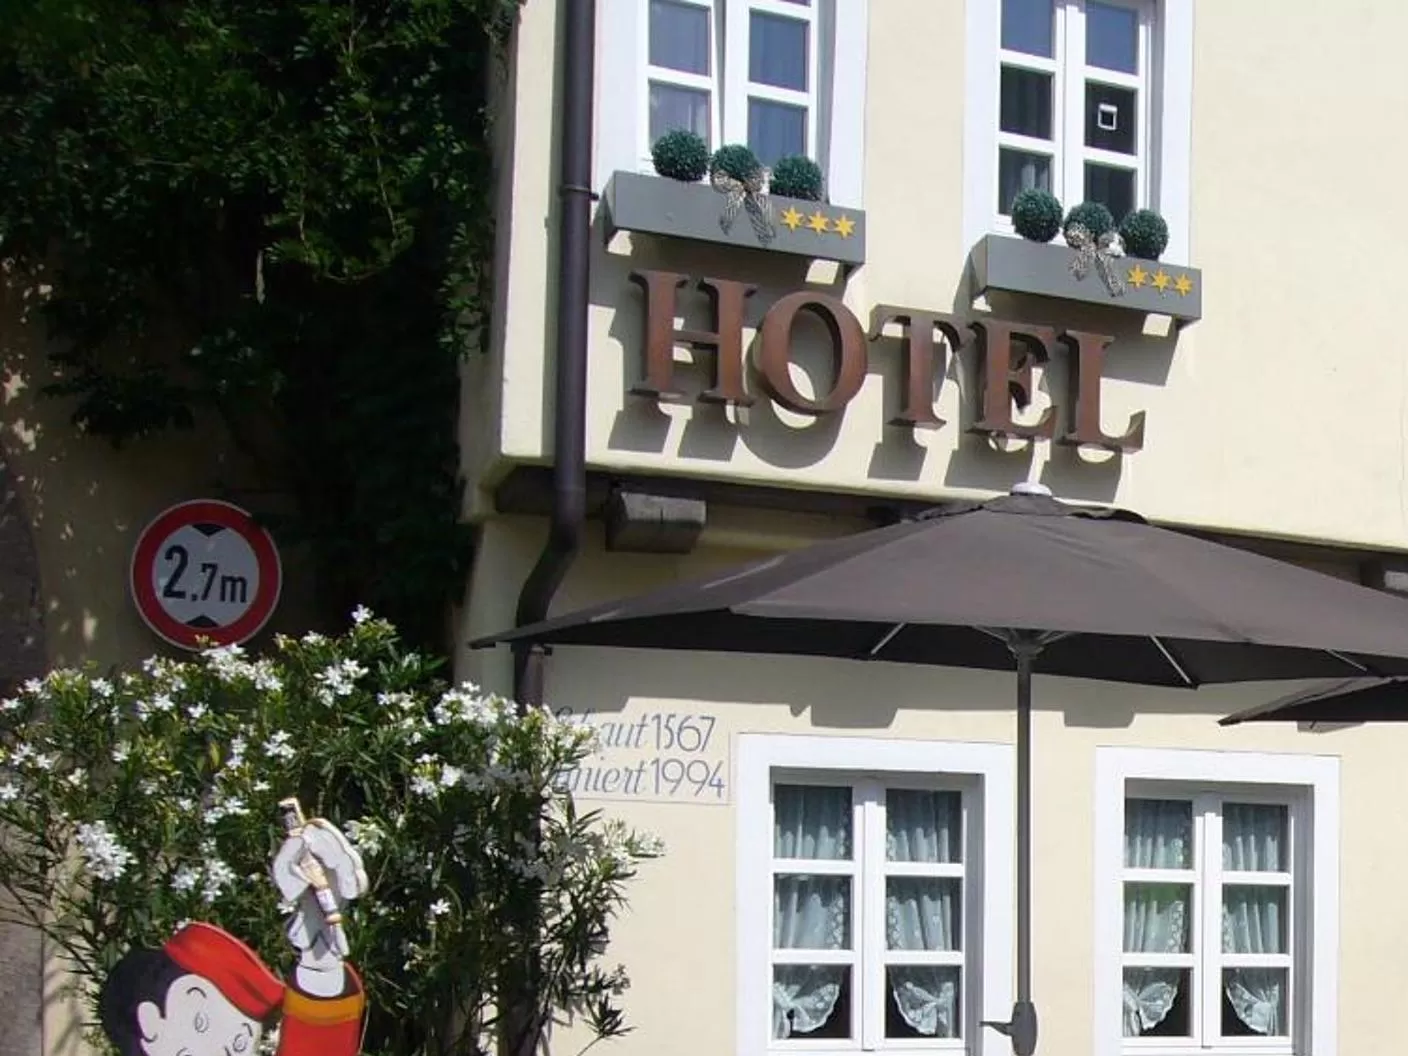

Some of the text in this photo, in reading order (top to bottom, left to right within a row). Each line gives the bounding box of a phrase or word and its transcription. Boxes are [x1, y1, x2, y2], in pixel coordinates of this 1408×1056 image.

[628, 270, 1146, 454] HOTEL
[651, 713, 716, 753] 1567
[650, 758, 726, 798] 1994
